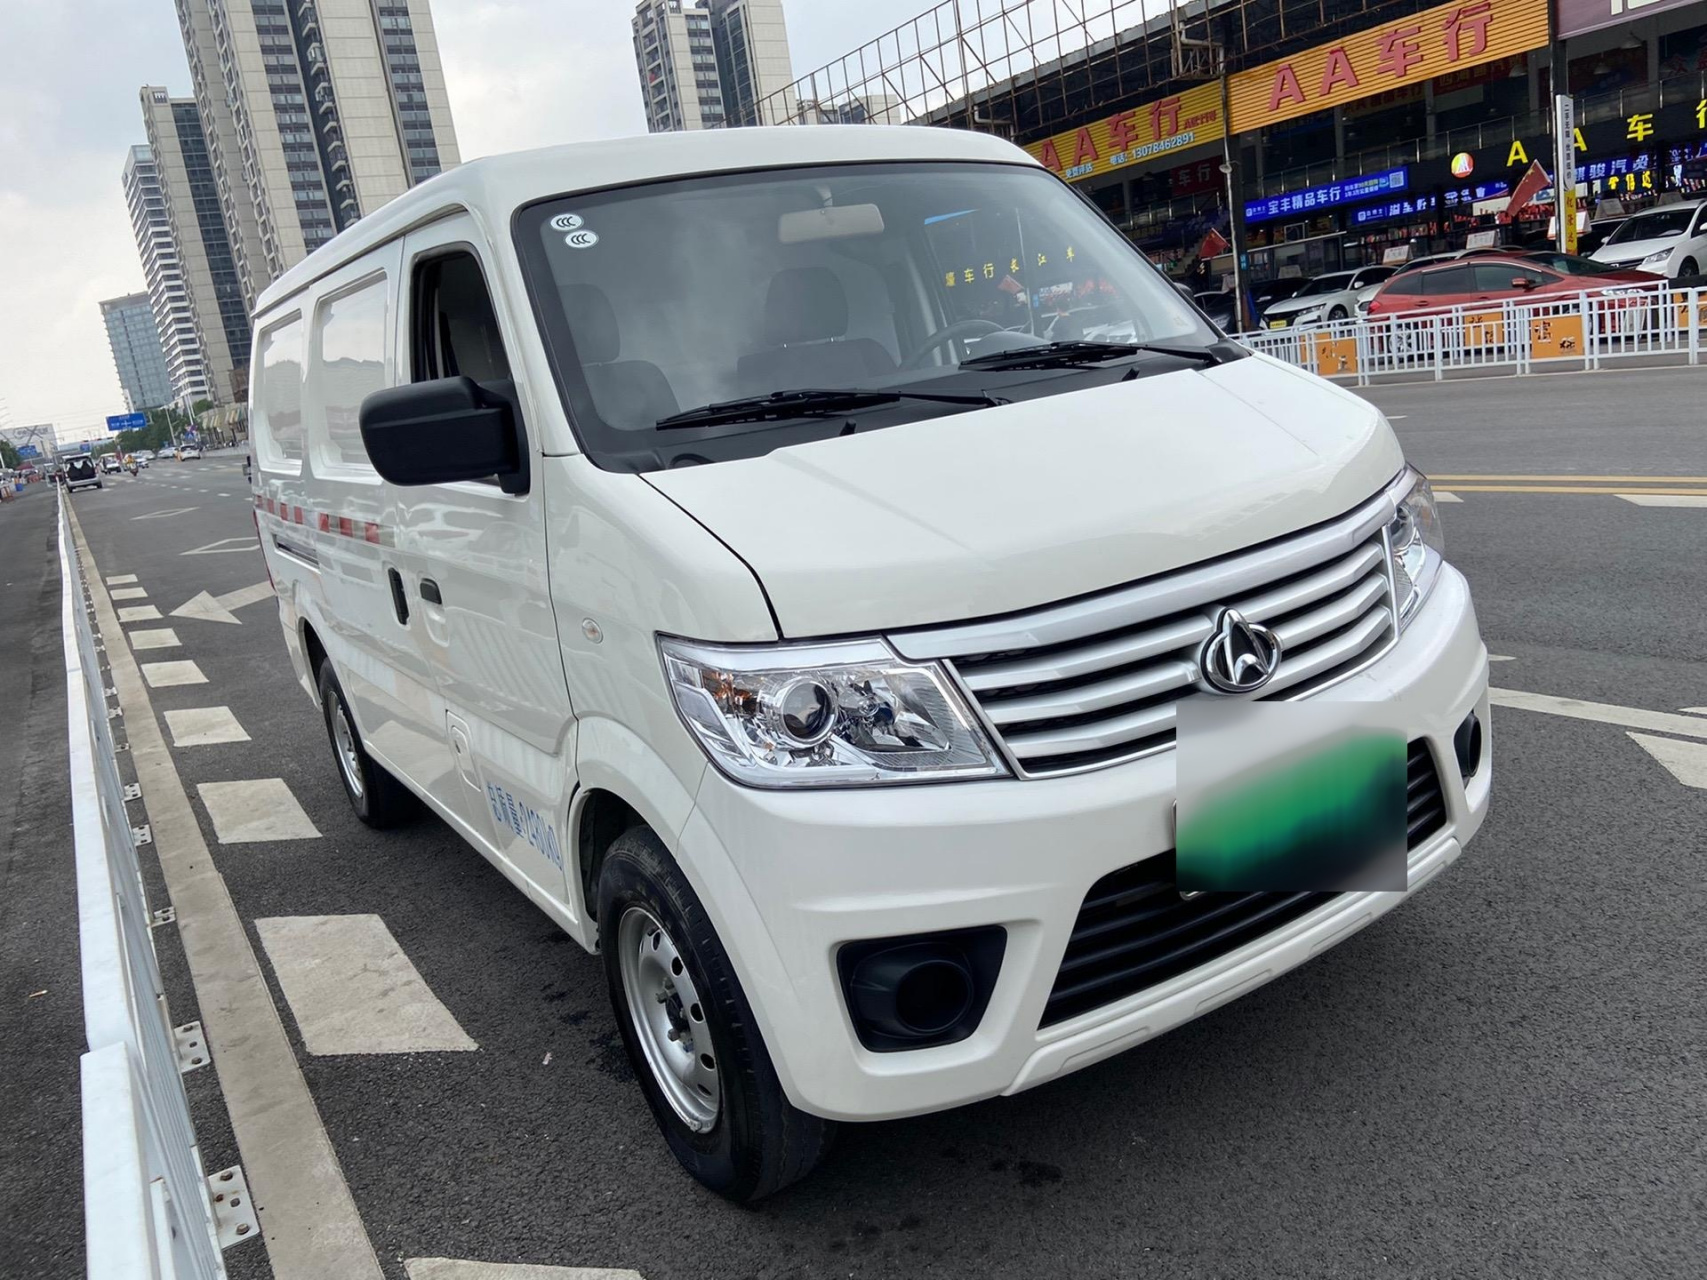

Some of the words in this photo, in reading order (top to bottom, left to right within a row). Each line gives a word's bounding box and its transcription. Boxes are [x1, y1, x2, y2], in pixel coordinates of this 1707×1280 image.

[1268, 2, 1493, 112] AA车行
[1041, 96, 1181, 172] AA车行
[1268, 186, 1341, 215] 宝丰精品车行
